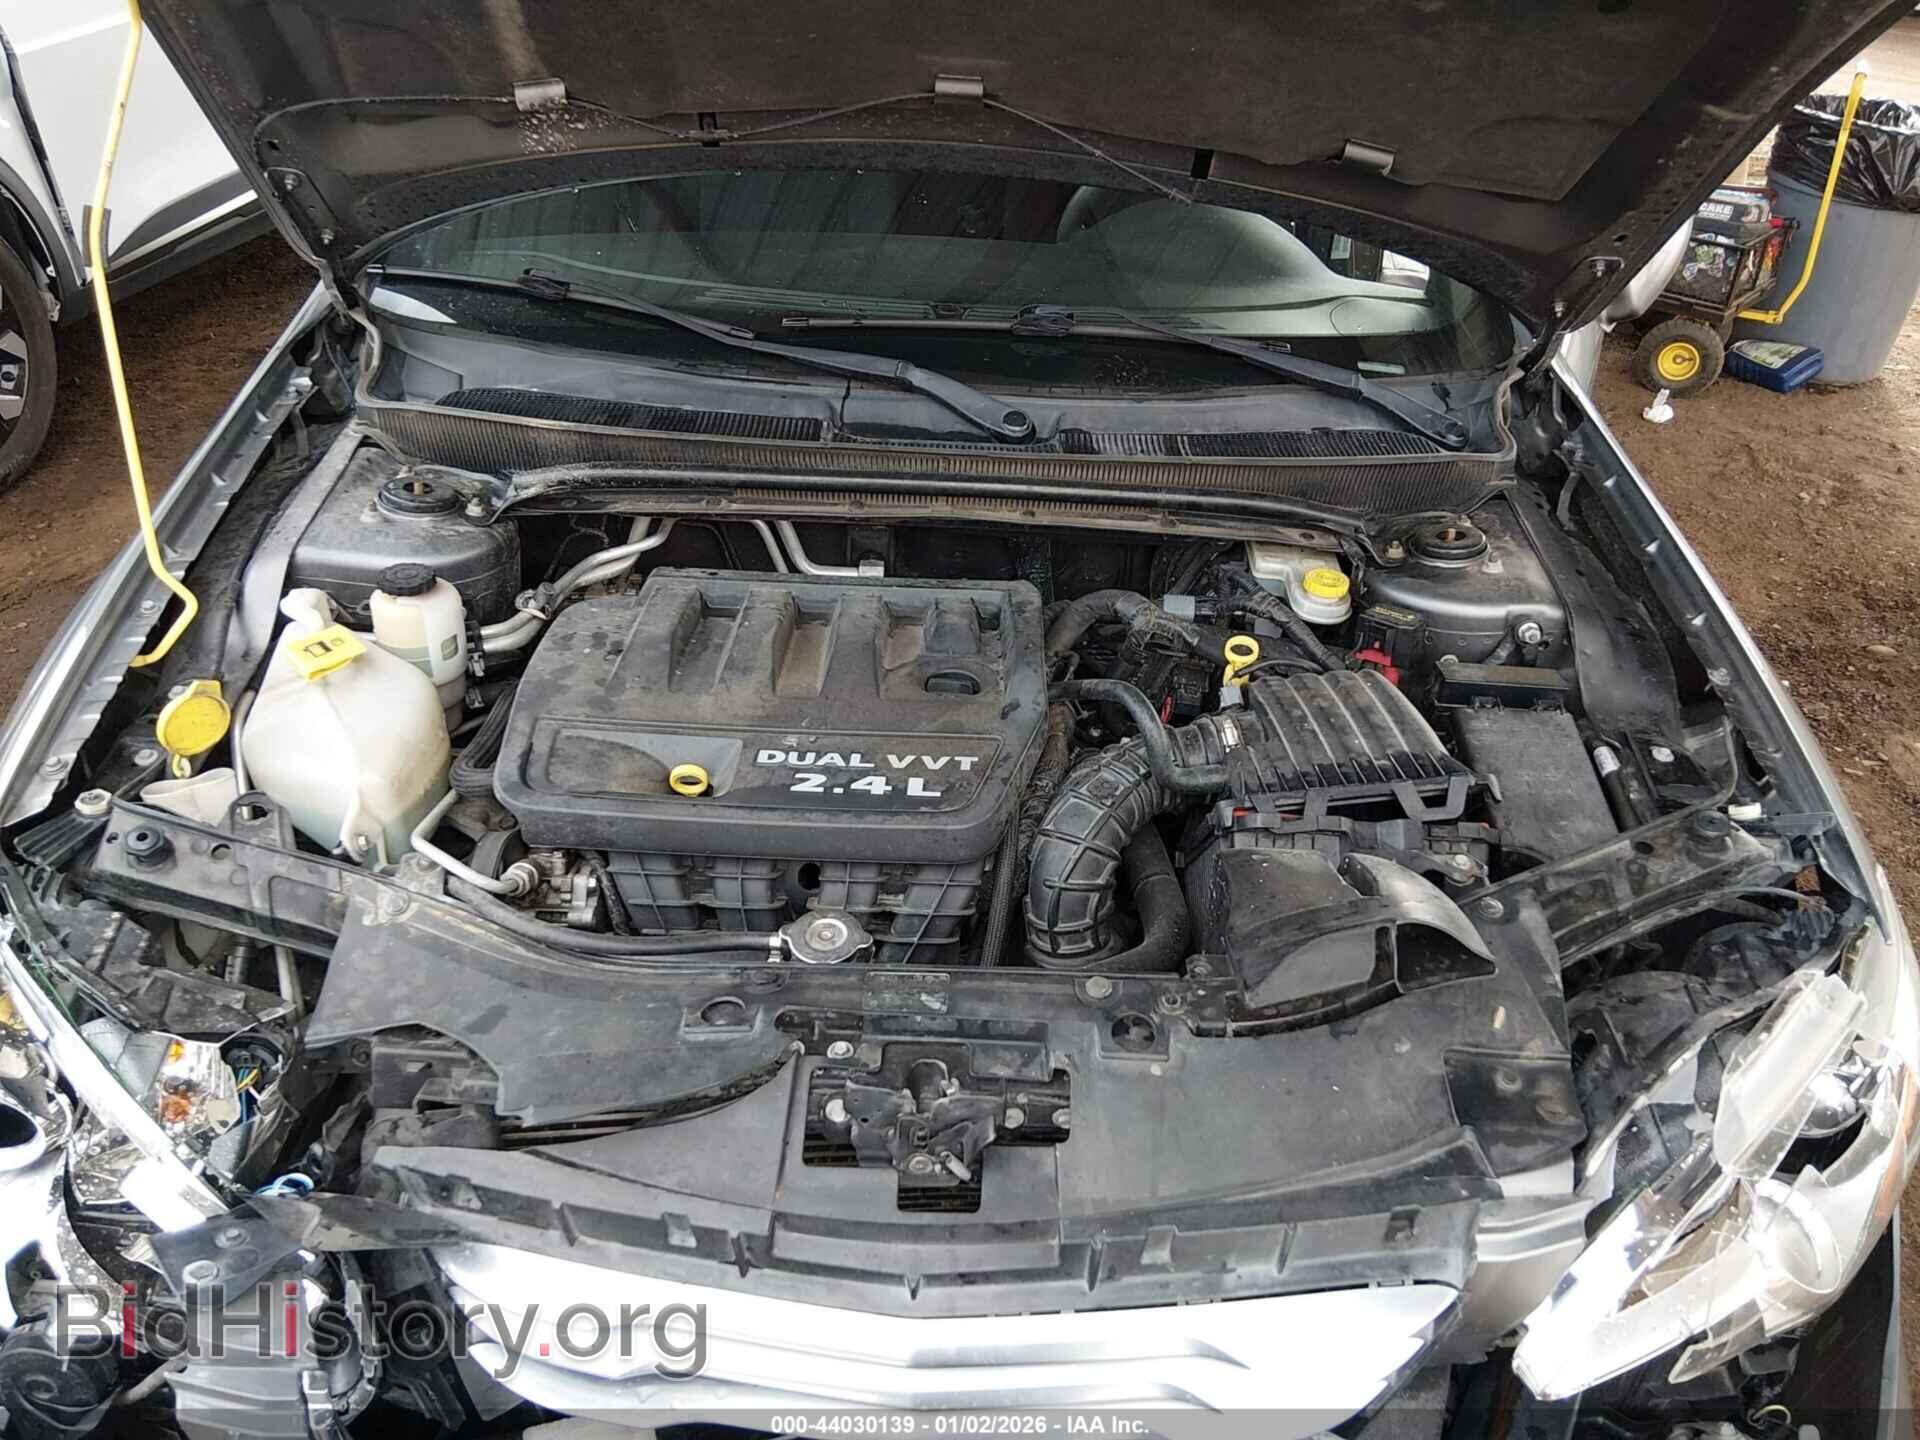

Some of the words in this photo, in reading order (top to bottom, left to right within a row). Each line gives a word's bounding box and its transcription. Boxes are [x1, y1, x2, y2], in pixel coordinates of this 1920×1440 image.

[756, 749, 875, 768] DUAL
[886, 754, 979, 771] VVT
[790, 772, 893, 796] 2.4
[906, 777, 942, 797] L
